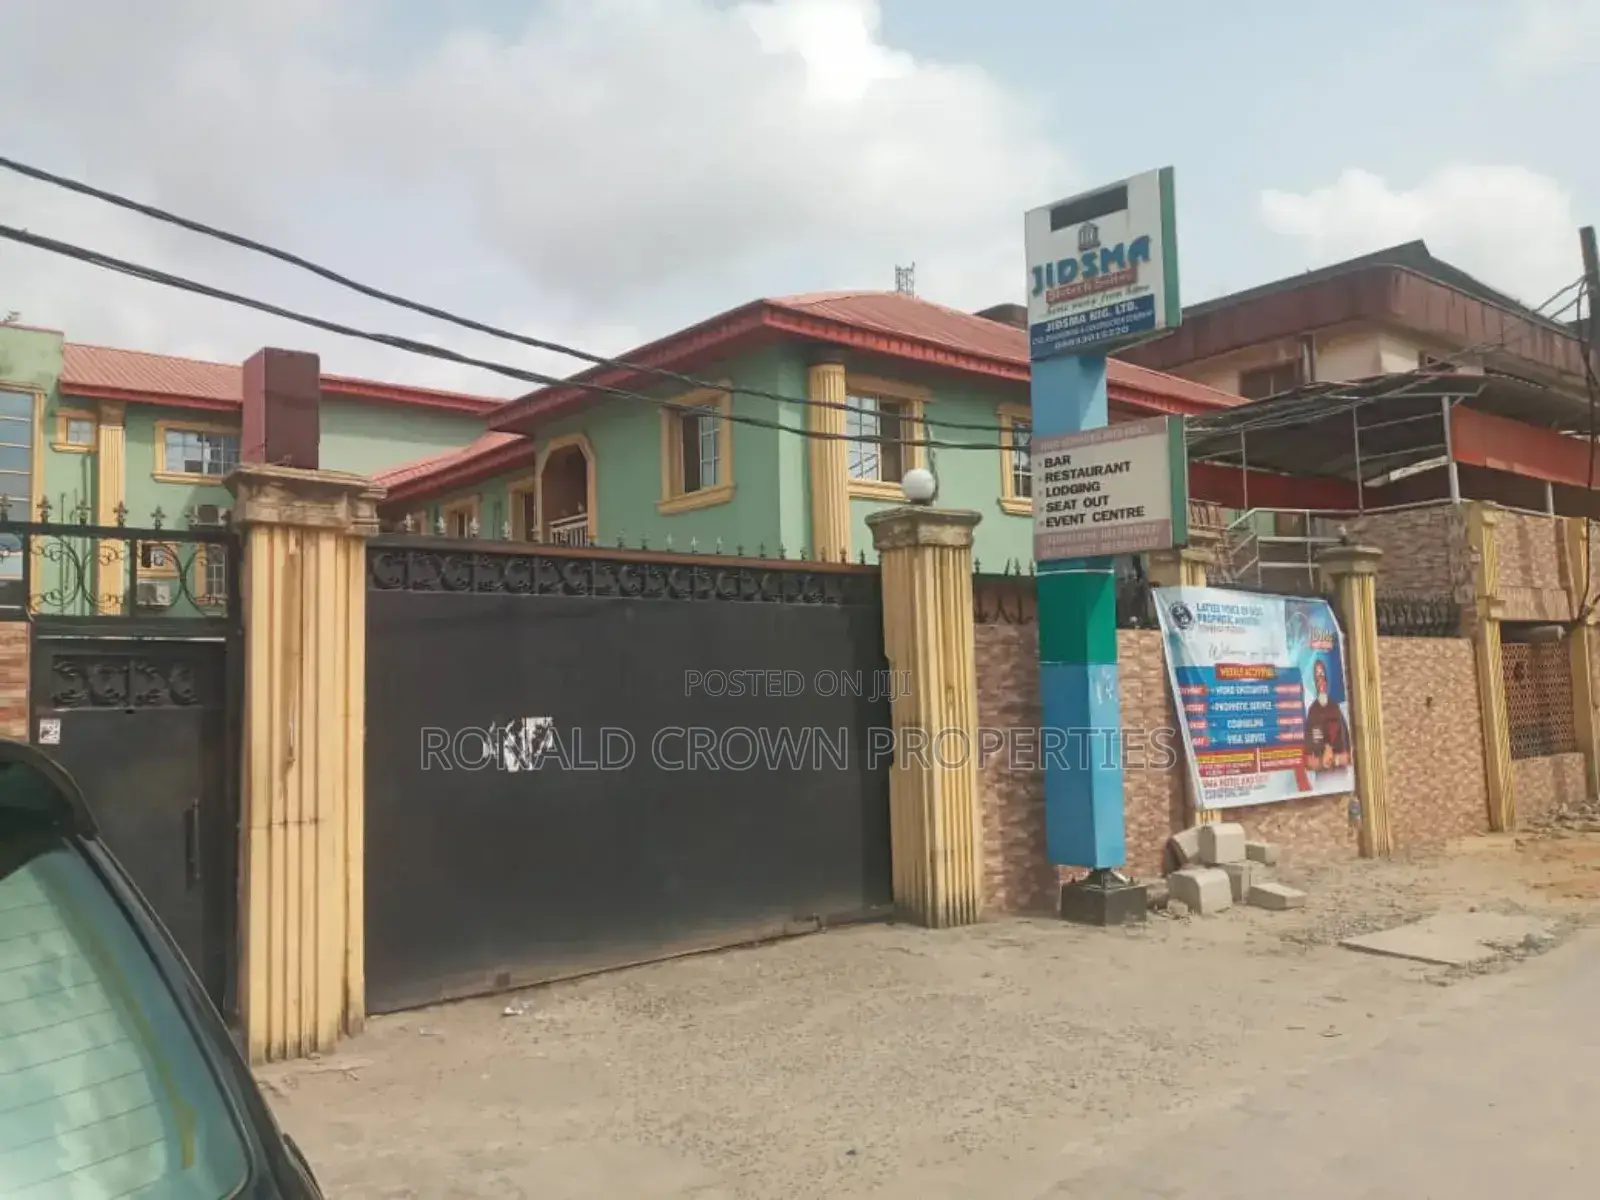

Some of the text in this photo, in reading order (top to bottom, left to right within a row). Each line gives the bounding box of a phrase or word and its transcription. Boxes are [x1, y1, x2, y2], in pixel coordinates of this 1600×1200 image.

[1031, 235, 1152, 297] JIDSMA
[1045, 315, 1087, 332] JIDSMA
[1044, 455, 1071, 468] BAR
[1045, 461, 1131, 483] RESTAURANT
[1045, 481, 1101, 498] LODGING
[1046, 495, 1110, 513] SEAT OUT
[1046, 506, 1145, 528] EVENT CENTRE
